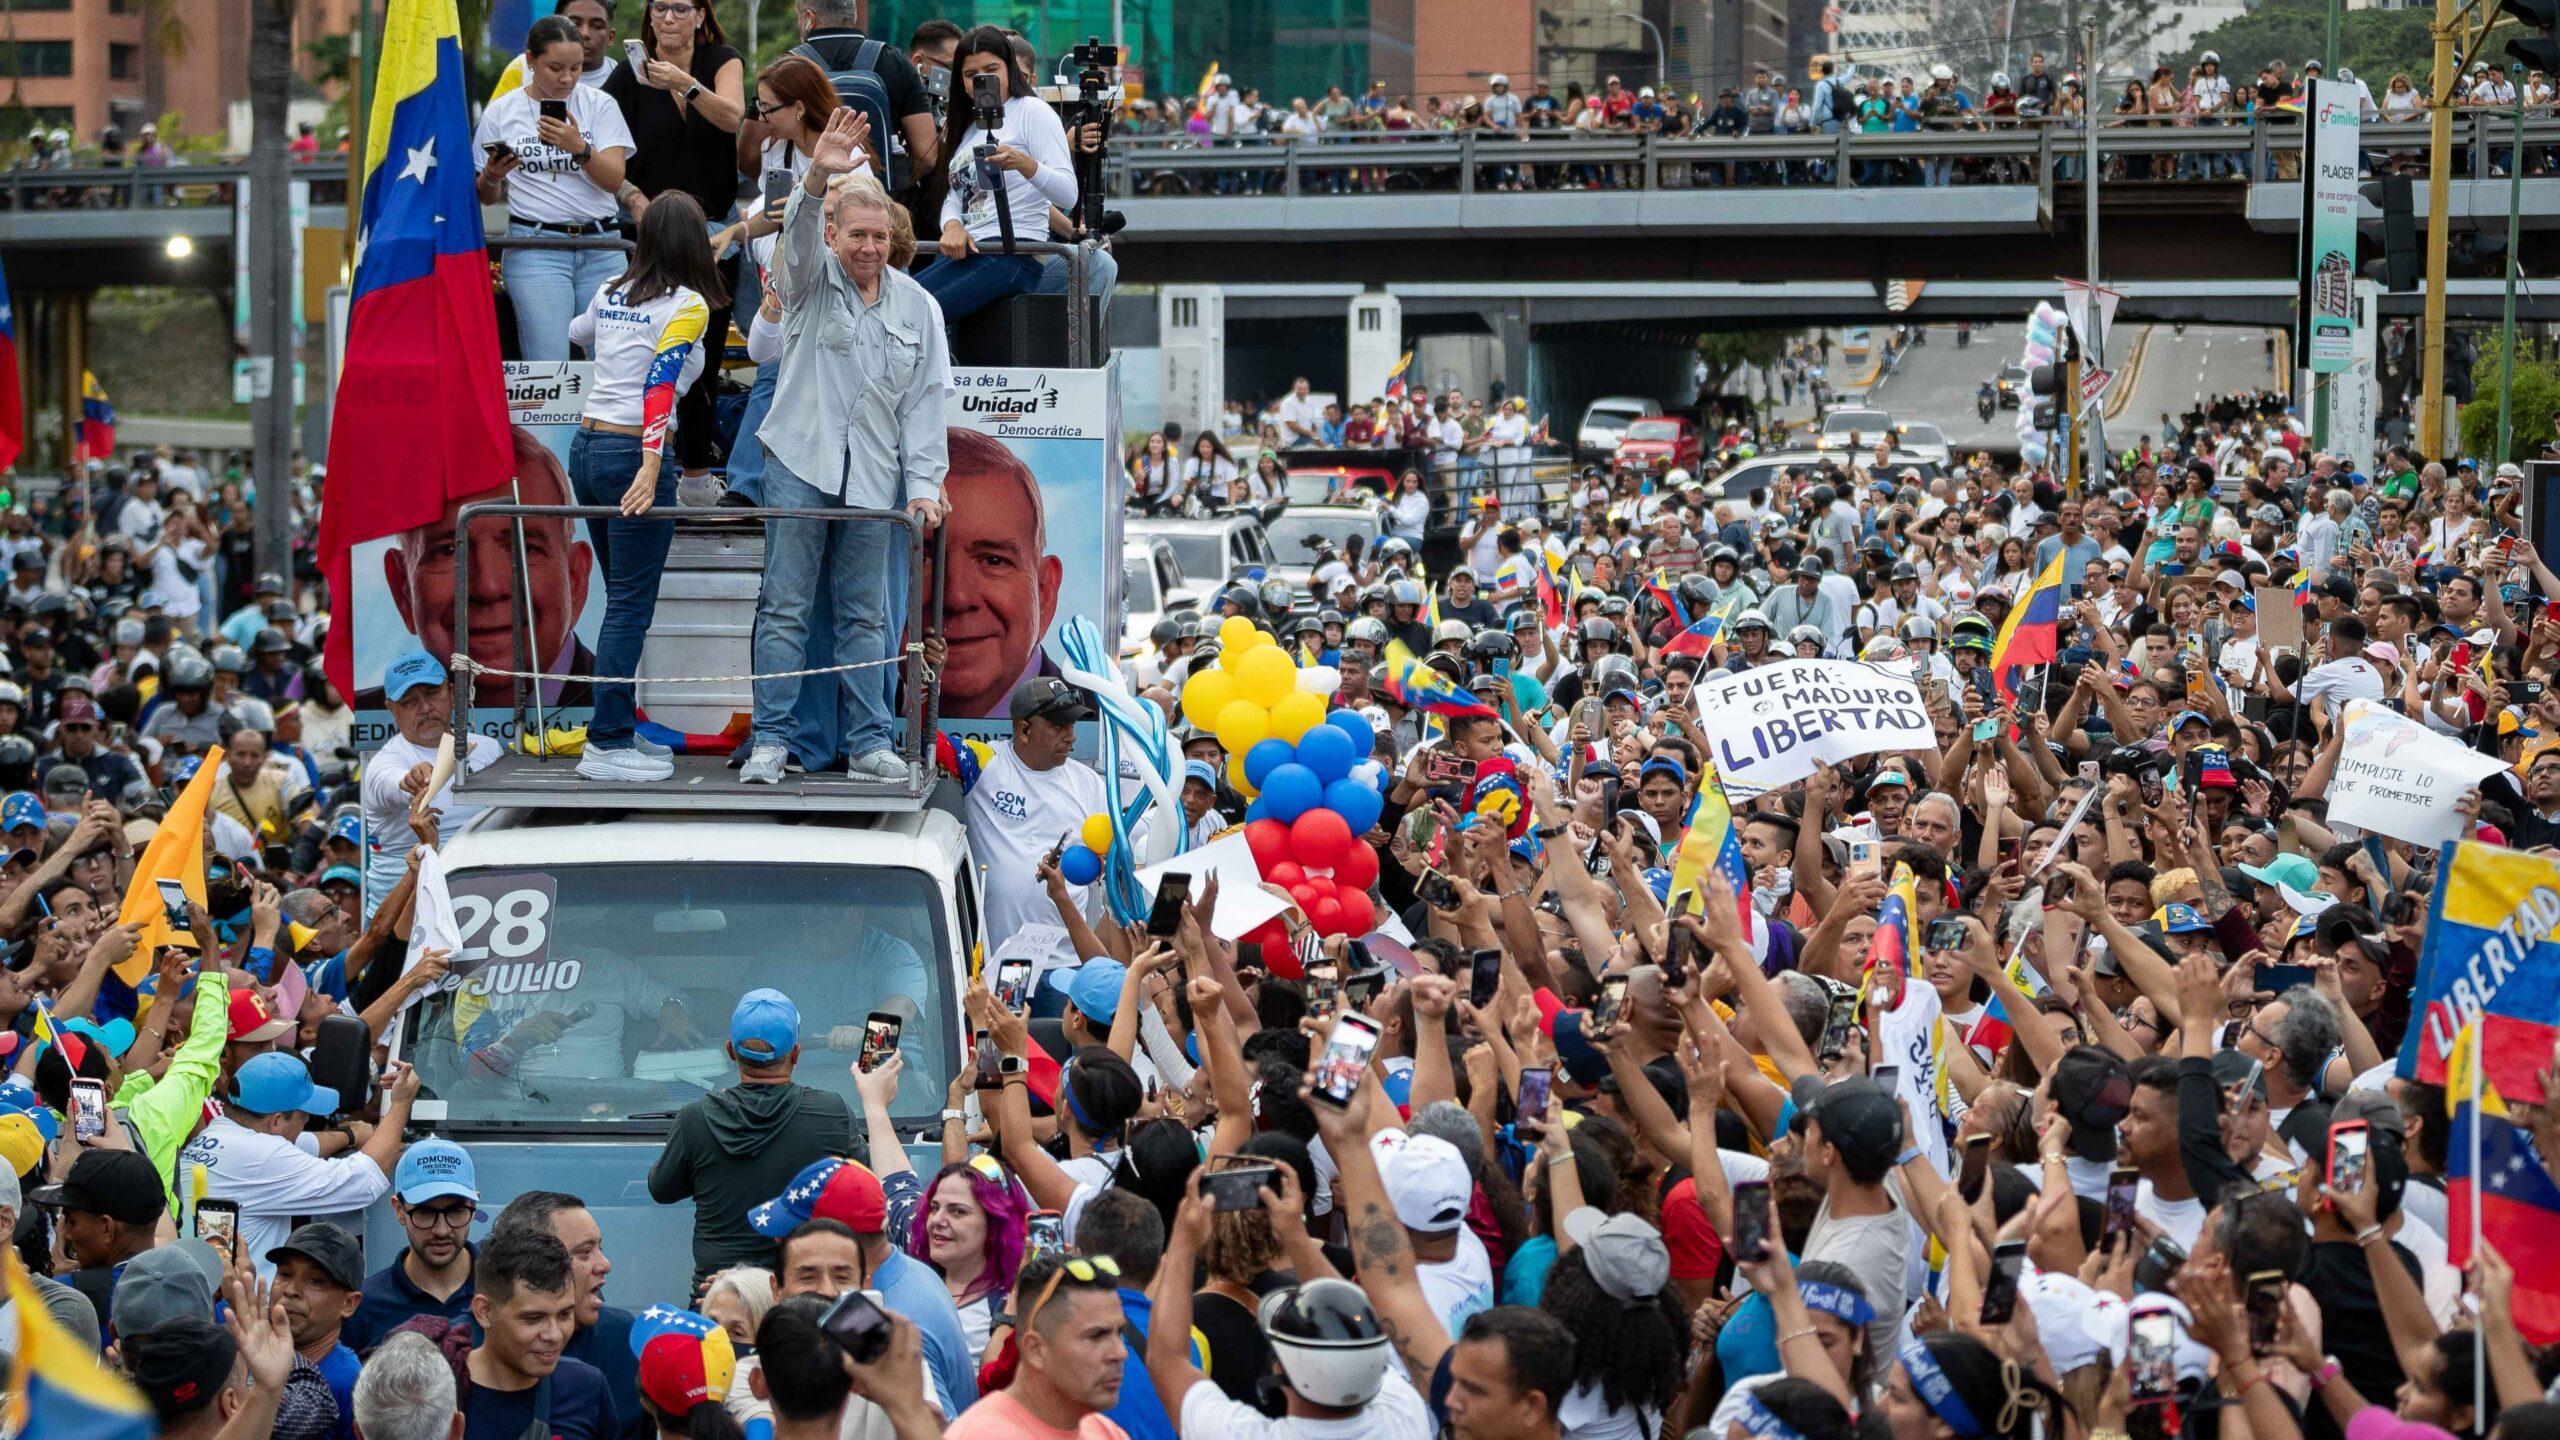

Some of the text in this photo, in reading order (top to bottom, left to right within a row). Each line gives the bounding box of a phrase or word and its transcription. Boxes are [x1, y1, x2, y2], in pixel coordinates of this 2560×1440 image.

[2321, 164, 2355, 180] PLACER
[2325, 191, 2336, 201] una
[976, 373, 994, 387] de
[996, 374, 1008, 388] la
[962, 395, 1038, 414] Unidad
[998, 423, 1082, 437] Democrática
[1722, 667, 1830, 705] FUERA
[1782, 687, 1914, 710] MADURO
[1721, 708, 1926, 773] LIBERTAD
[2337, 757, 2434, 789] CUMPLISTE LO
[996, 791, 1026, 807] CON
[2368, 784, 2434, 808] PROMETISTE
[450, 889, 550, 962] 28
[471, 959, 582, 996] JULIO
[2429, 886, 2560, 1061] LIBERTAD
[416, 1154, 462, 1167] EDMUNDO
[423, 1163, 457, 1171] PRESIDENTE
